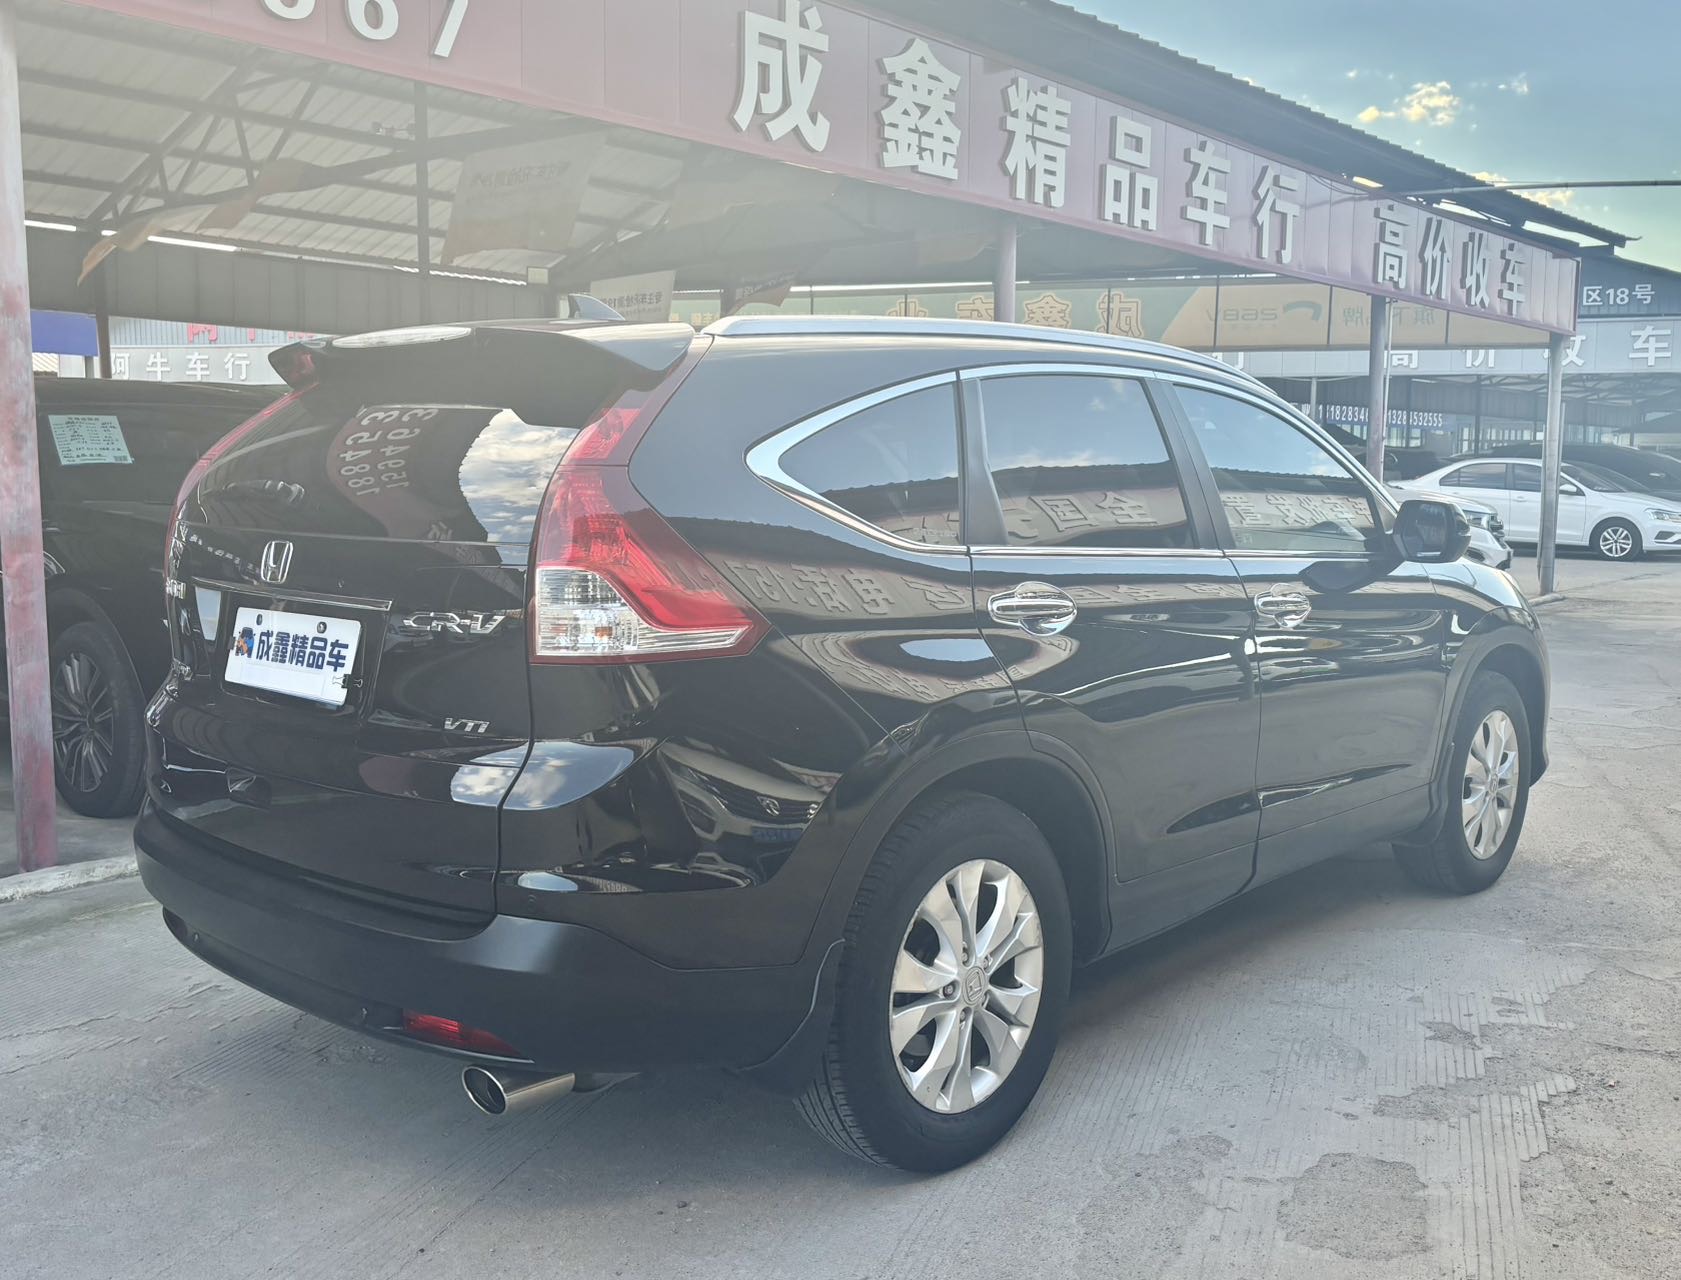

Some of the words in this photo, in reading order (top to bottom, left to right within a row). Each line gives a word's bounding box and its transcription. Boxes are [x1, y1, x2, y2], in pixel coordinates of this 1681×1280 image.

[732, 0, 1301, 265] 成鑫精品车行
[1374, 203, 1527, 318] 高价收车
[1582, 284, 1656, 306] 区18号
[111, 351, 250, 381] 阿牛车行
[403, 611, 506, 634] CR-V
[256, 629, 349, 672] 成鑫精品车
